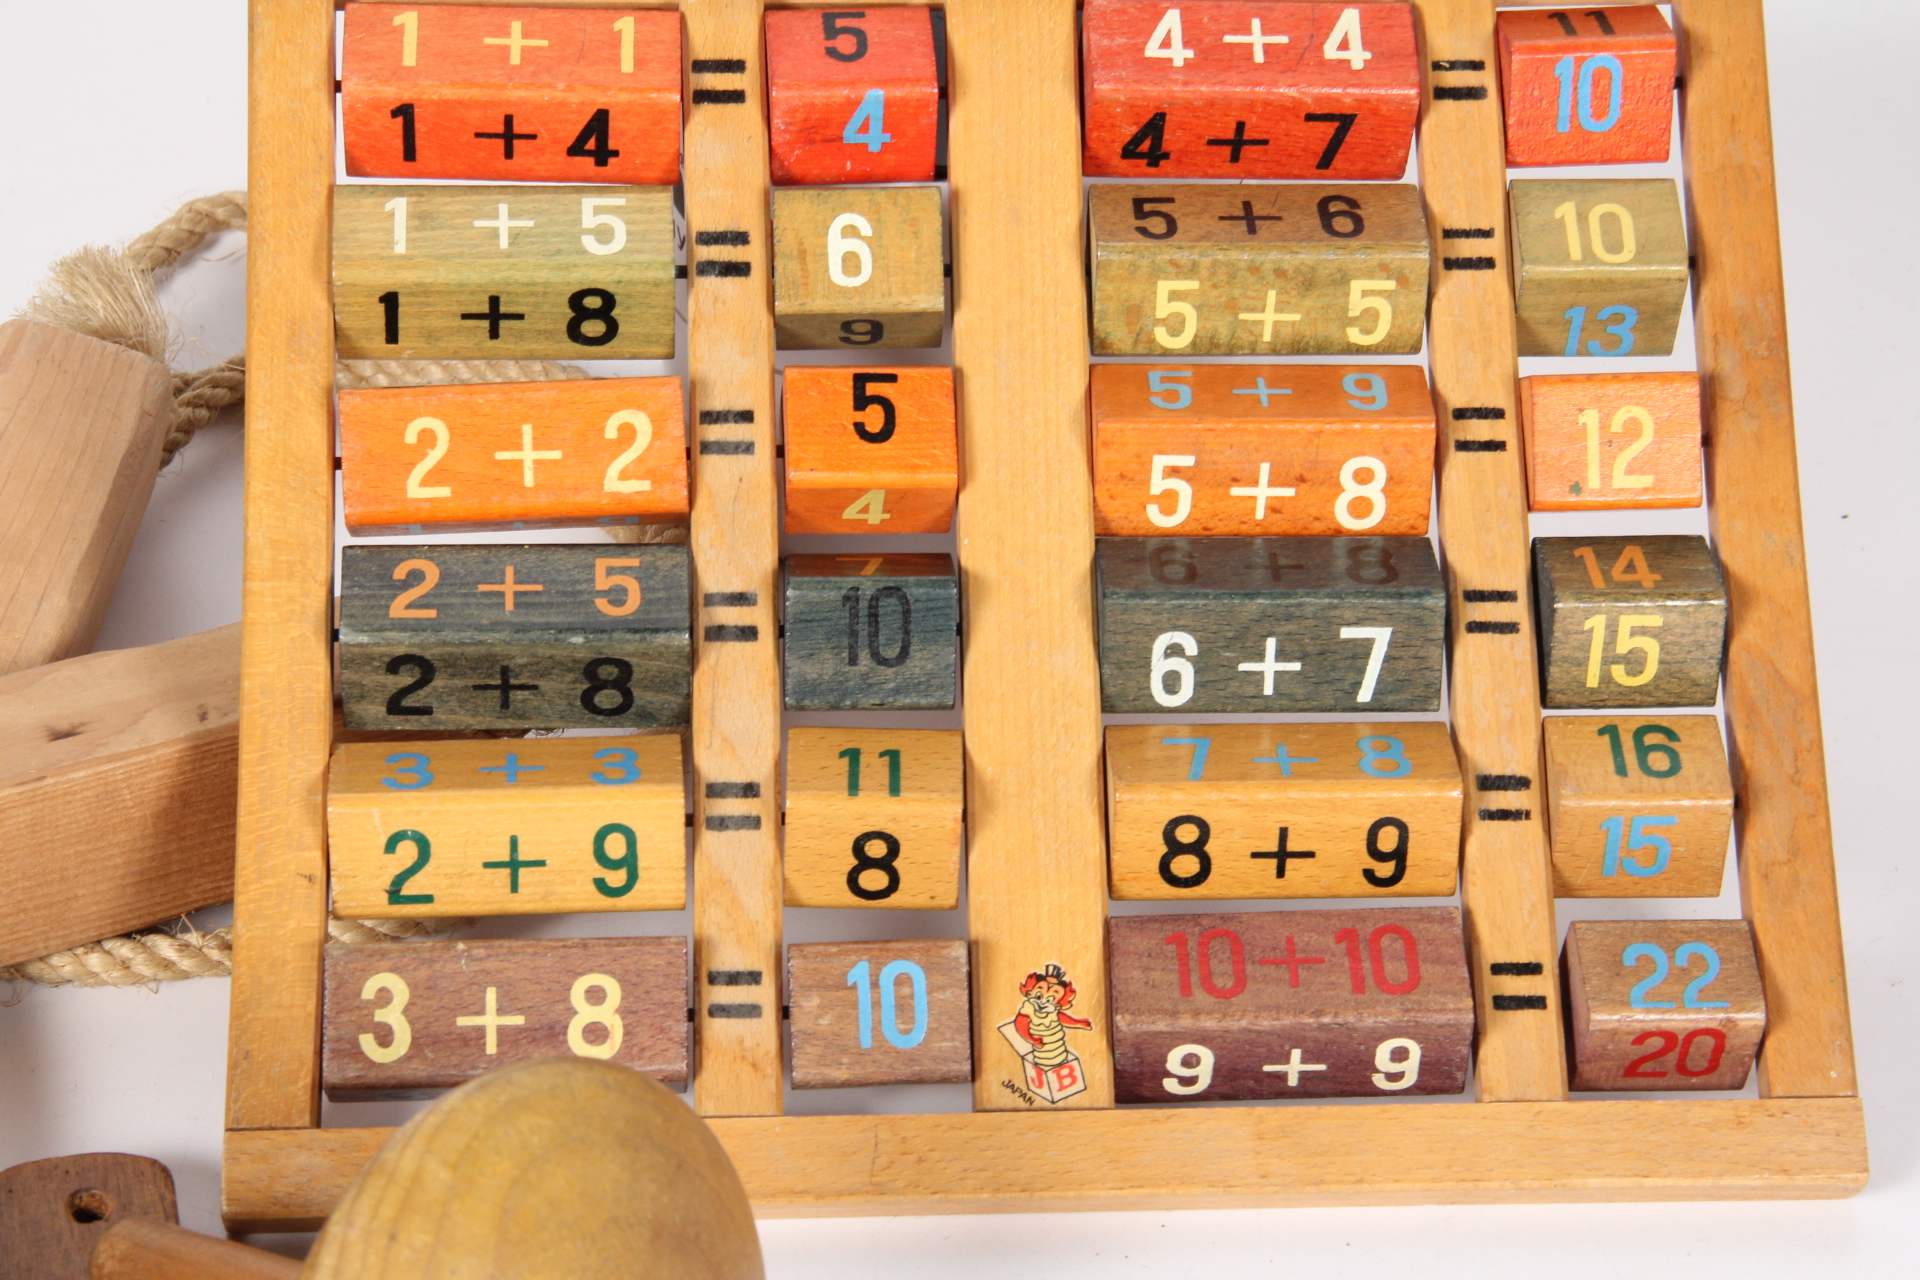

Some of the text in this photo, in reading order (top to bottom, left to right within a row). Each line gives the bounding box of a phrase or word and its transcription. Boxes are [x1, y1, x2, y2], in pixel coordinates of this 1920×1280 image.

[392, 12, 418, 66] 1
[613, 17, 634, 73] 1
[821, 12, 868, 62] 5
[1144, 9, 1194, 66] 4
[1323, 9, 1372, 70] 4
[1547, 11, 1615, 36] 11
[843, 88, 891, 152] 4
[1554, 55, 1623, 132] 10
[391, 103, 416, 162] 1
[567, 109, 619, 167] 4
[1121, 112, 1170, 167] 4
[1304, 113, 1358, 170] 7
[385, 197, 407, 253] 1
[581, 198, 627, 255] 5
[1132, 197, 1178, 239] 5
[1317, 195, 1365, 238] 6
[1554, 202, 1636, 263] 10
[828, 213, 873, 287] 6
[378, 292, 399, 344] 1
[567, 288, 619, 346] 8
[839, 319, 883, 345] 9
[1154, 280, 1200, 348] 5
[1346, 280, 1396, 345] 5
[1564, 305, 1638, 356] 13
[852, 373, 898, 443] 5
[1148, 371, 1193, 409] 5
[1342, 373, 1388, 411] 9
[404, 417, 451, 498] 2
[604, 409, 652, 493] 2
[1578, 406, 1654, 489] 12
[843, 489, 891, 524] 4
[1146, 455, 1195, 527] 5
[1334, 456, 1387, 530] 8
[389, 559, 440, 618] 2
[594, 558, 641, 616] 5
[835, 558, 884, 575] 7
[1149, 545, 1197, 585] 6
[1345, 545, 1399, 585] 8
[1573, 546, 1662, 588] 14
[843, 586, 911, 668] 10
[1584, 615, 1664, 688] 15
[386, 654, 436, 716] 2
[580, 657, 634, 716] 8
[1150, 631, 1198, 707] 6
[1340, 627, 1393, 702] 7
[381, 752, 434, 790] 3
[589, 748, 642, 785] 3
[838, 748, 901, 797] 11
[1162, 738, 1212, 781] 7
[1356, 735, 1412, 778] 8
[1596, 724, 1682, 778] 16
[383, 829, 434, 905] 2
[593, 823, 638, 897] 9
[846, 831, 900, 900] 8
[1159, 815, 1211, 888] 8
[1363, 817, 1409, 887] 9
[1600, 816, 1678, 877] 15
[847, 960, 928, 1049] 10
[1622, 942, 1730, 1008] 22
[358, 972, 412, 1064] 3
[567, 973, 623, 1060] 8
[1162, 1044, 1215, 1095] 9
[1371, 1038, 1421, 1090] 9
[1622, 1028, 1726, 1078] 20
[1002, 1079, 1035, 1106] JAPAN
